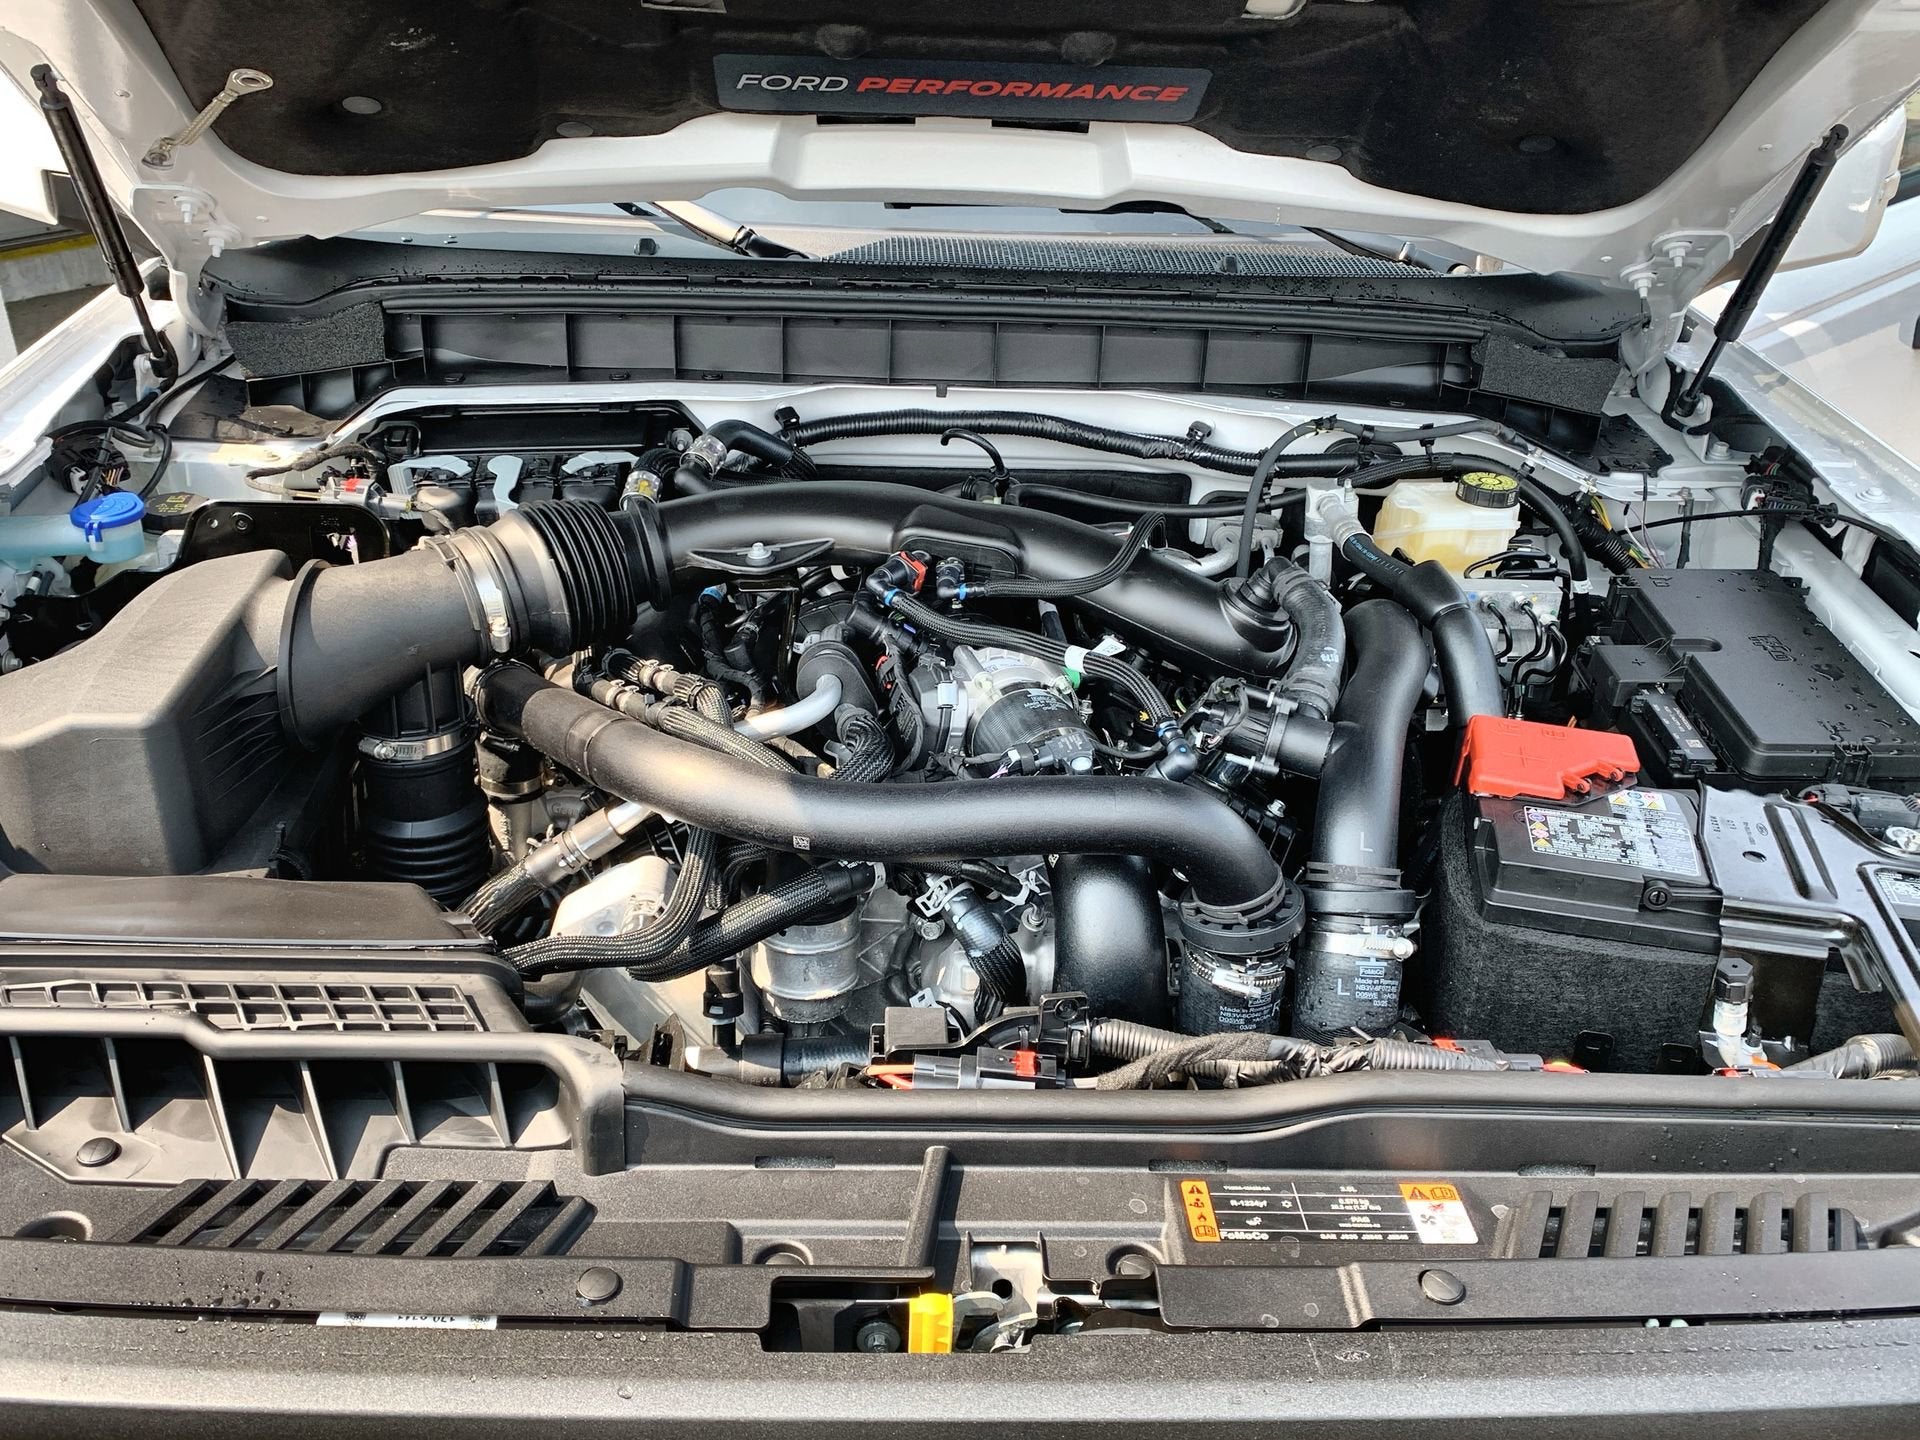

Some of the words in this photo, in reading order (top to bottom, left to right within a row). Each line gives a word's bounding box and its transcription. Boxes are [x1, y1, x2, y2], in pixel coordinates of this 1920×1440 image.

[736, 73, 849, 92] FORD
[856, 76, 1189, 102] PERFORMANCE
[1360, 831, 1373, 852] L
[1338, 978, 1350, 996] L
[1355, 977, 1373, 985] Made
[1220, 1231, 1269, 1240] FoMoCo
